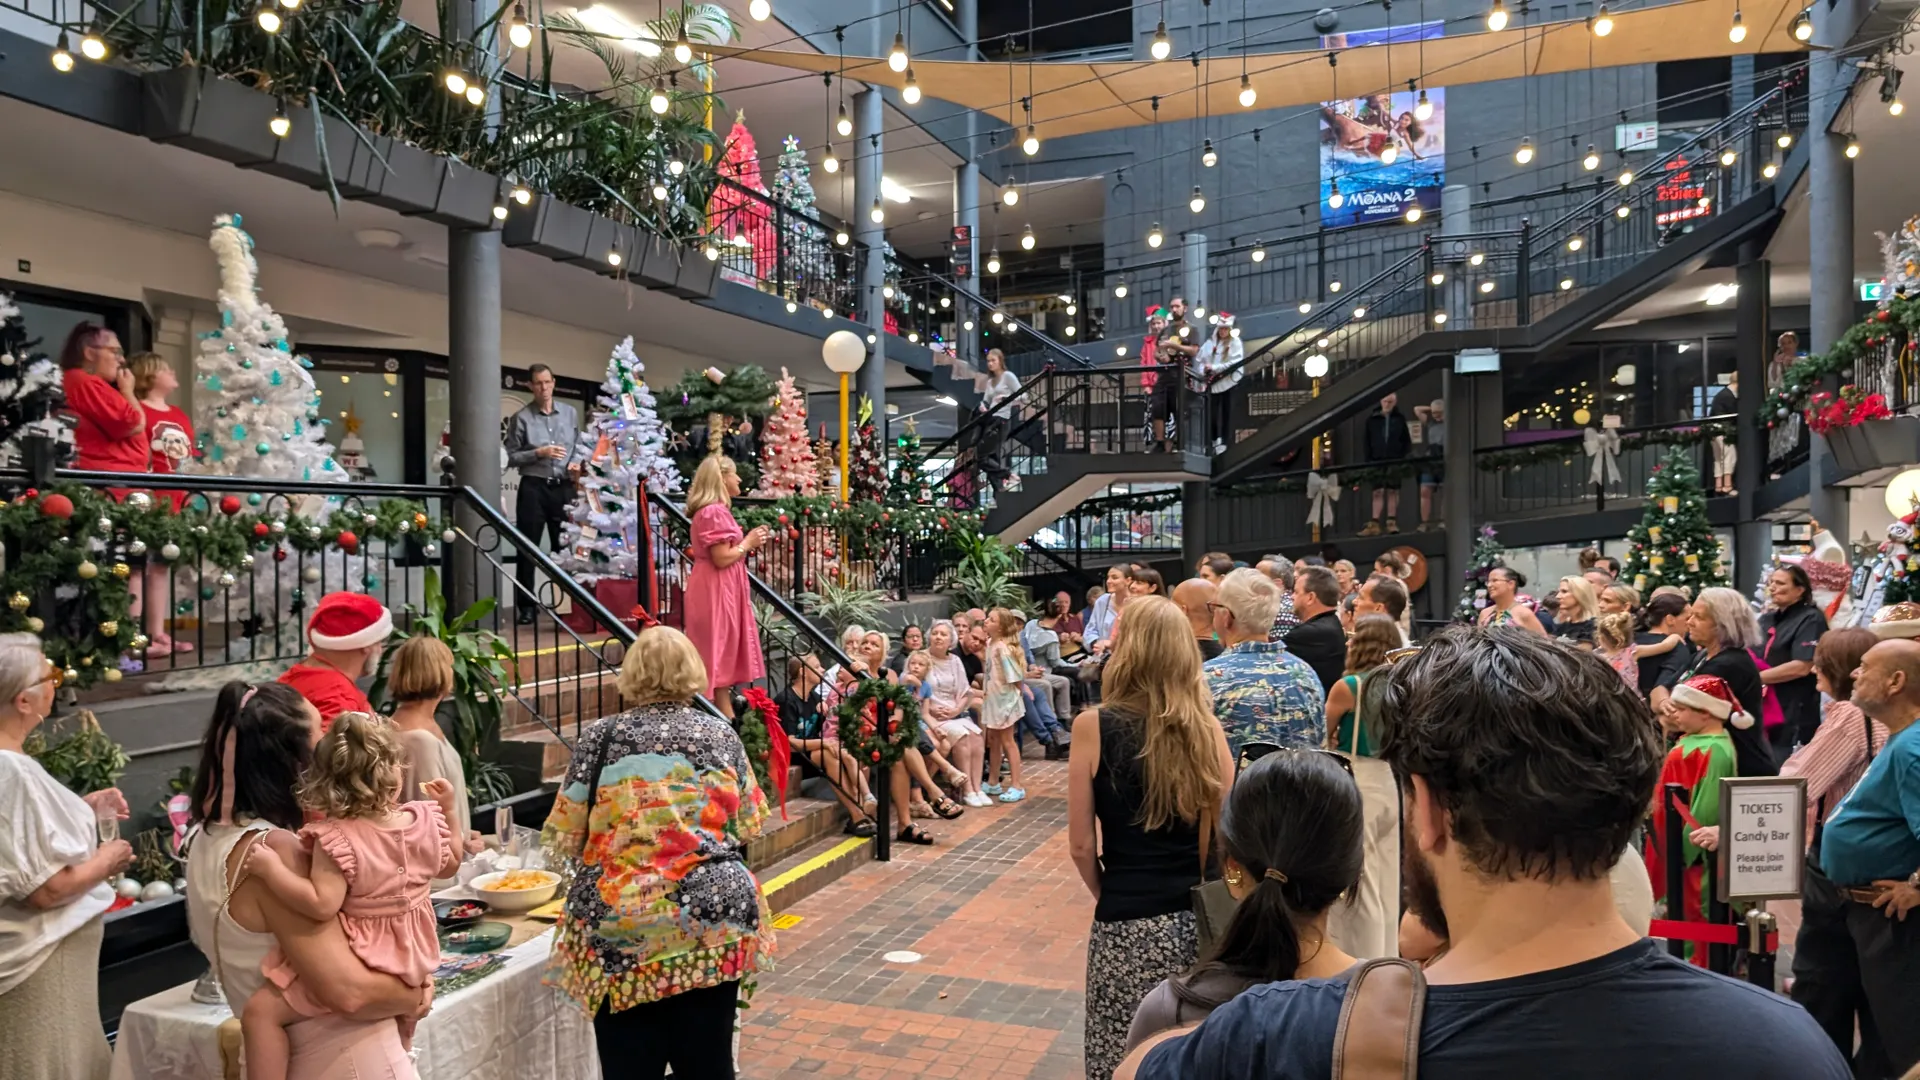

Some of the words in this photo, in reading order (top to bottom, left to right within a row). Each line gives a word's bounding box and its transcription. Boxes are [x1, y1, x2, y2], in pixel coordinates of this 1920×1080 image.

[1347, 191, 1402, 207] MOANA
[1404, 188, 1417, 202] 2
[1740, 803, 1783, 814] TICKETS
[1757, 817, 1766, 828] &
[1734, 831, 1769, 843] Candy
[1771, 830, 1790, 841] Bar
[1736, 853, 1765, 863] Please
[1766, 853, 1784, 864] join
[1738, 864, 1753, 873] the
[1755, 864, 1783, 874] queue
